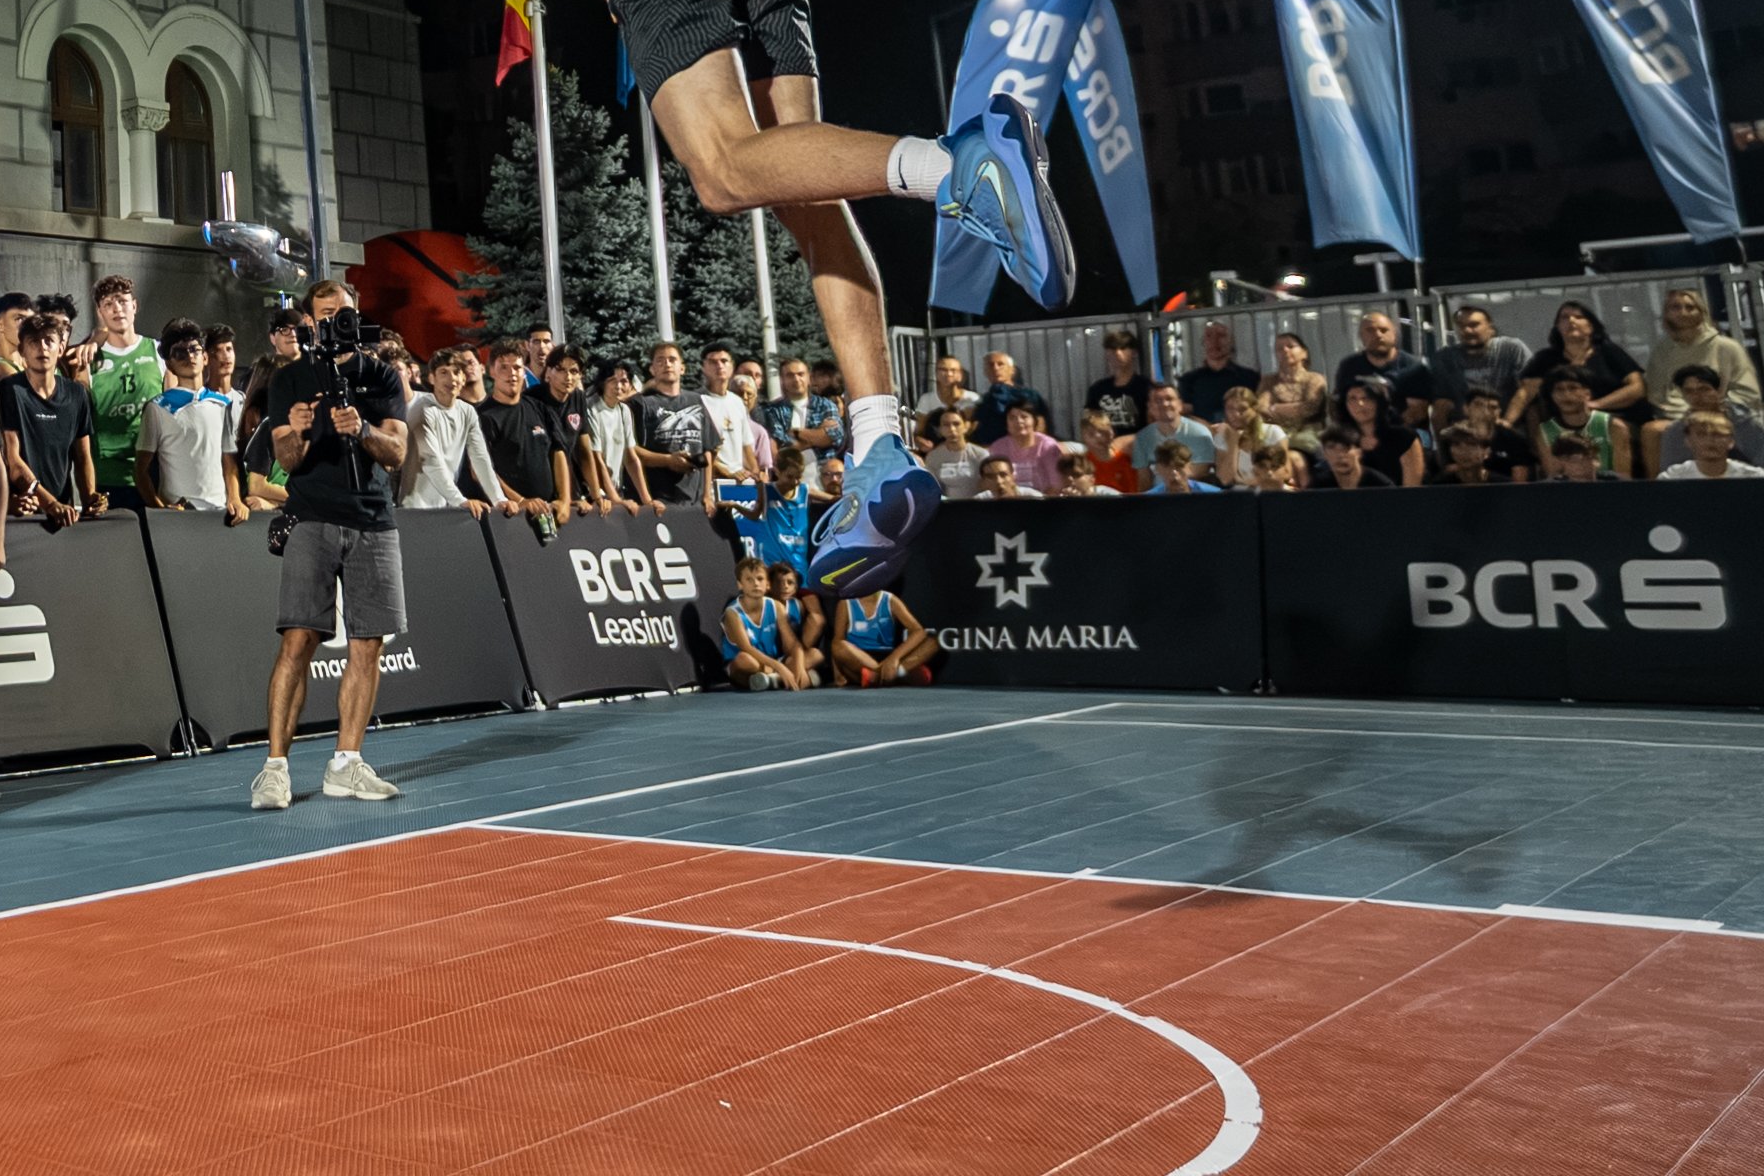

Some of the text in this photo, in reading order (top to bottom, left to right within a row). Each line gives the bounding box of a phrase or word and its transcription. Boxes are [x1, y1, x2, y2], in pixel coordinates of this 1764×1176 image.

[119, 374, 136, 394] 13
[569, 547, 661, 603] BCR
[1407, 559, 1610, 629] BCR
[588, 610, 679, 650] Leasing
[1025, 624, 1141, 651] MARIA
